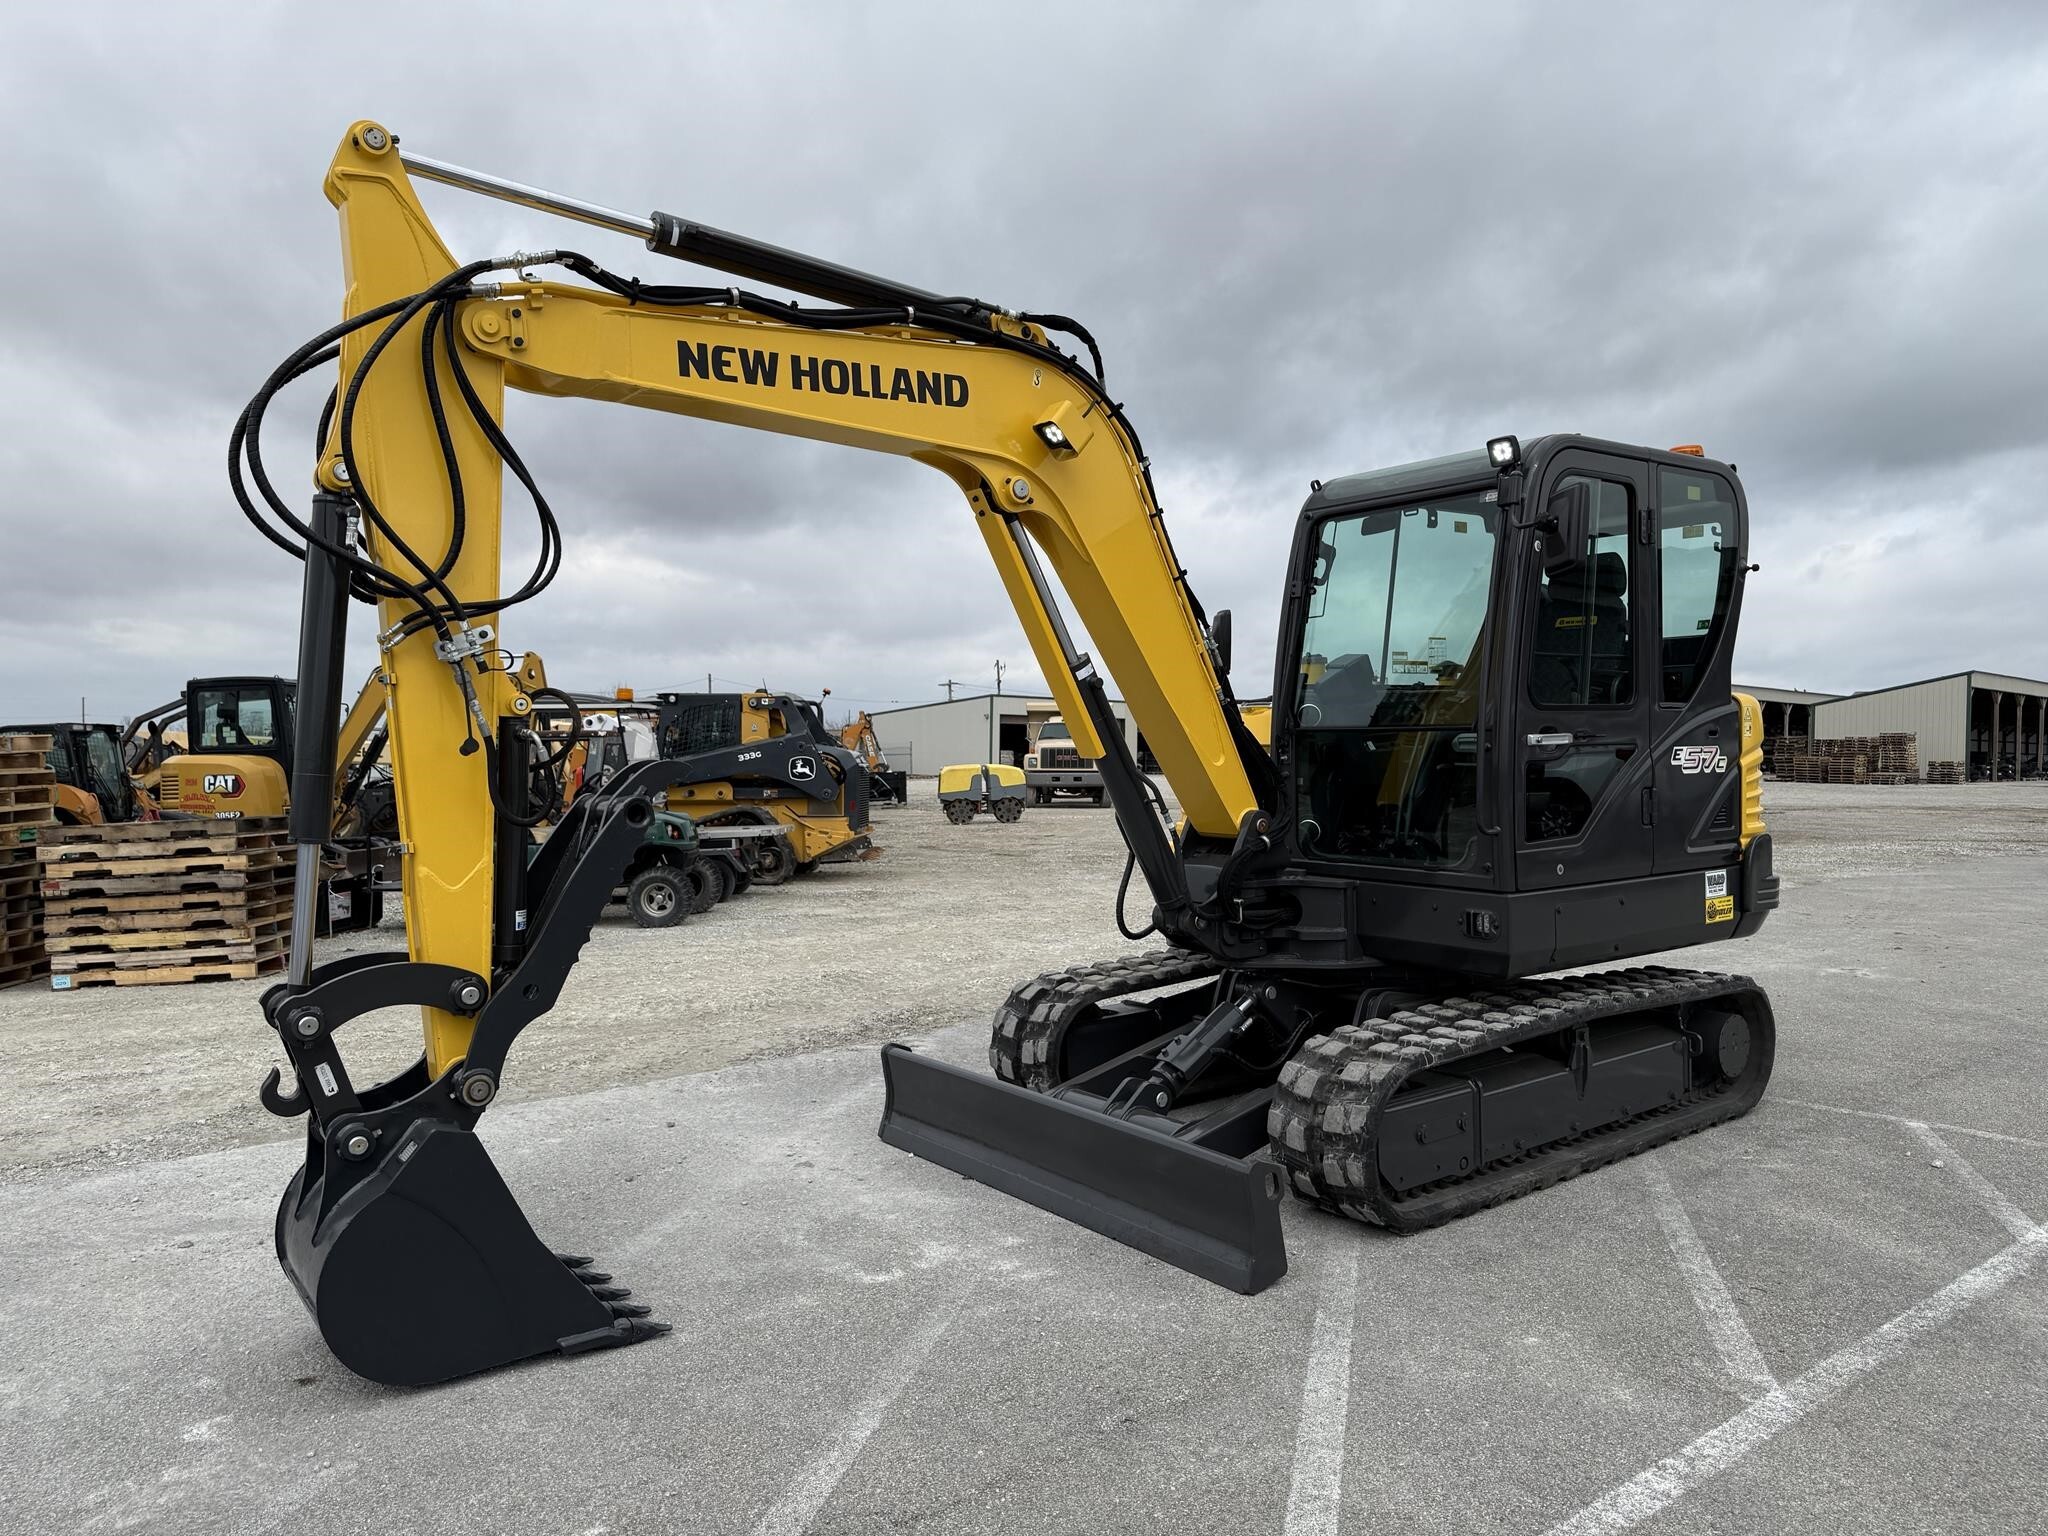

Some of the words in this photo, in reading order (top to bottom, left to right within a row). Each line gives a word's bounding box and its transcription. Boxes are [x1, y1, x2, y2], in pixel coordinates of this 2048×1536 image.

[677, 340, 779, 387] NEW
[790, 354, 969, 408] HOLLAND
[737, 751, 762, 762] 333G
[1671, 746, 1727, 774] E57C
[204, 775, 236, 793] CAT
